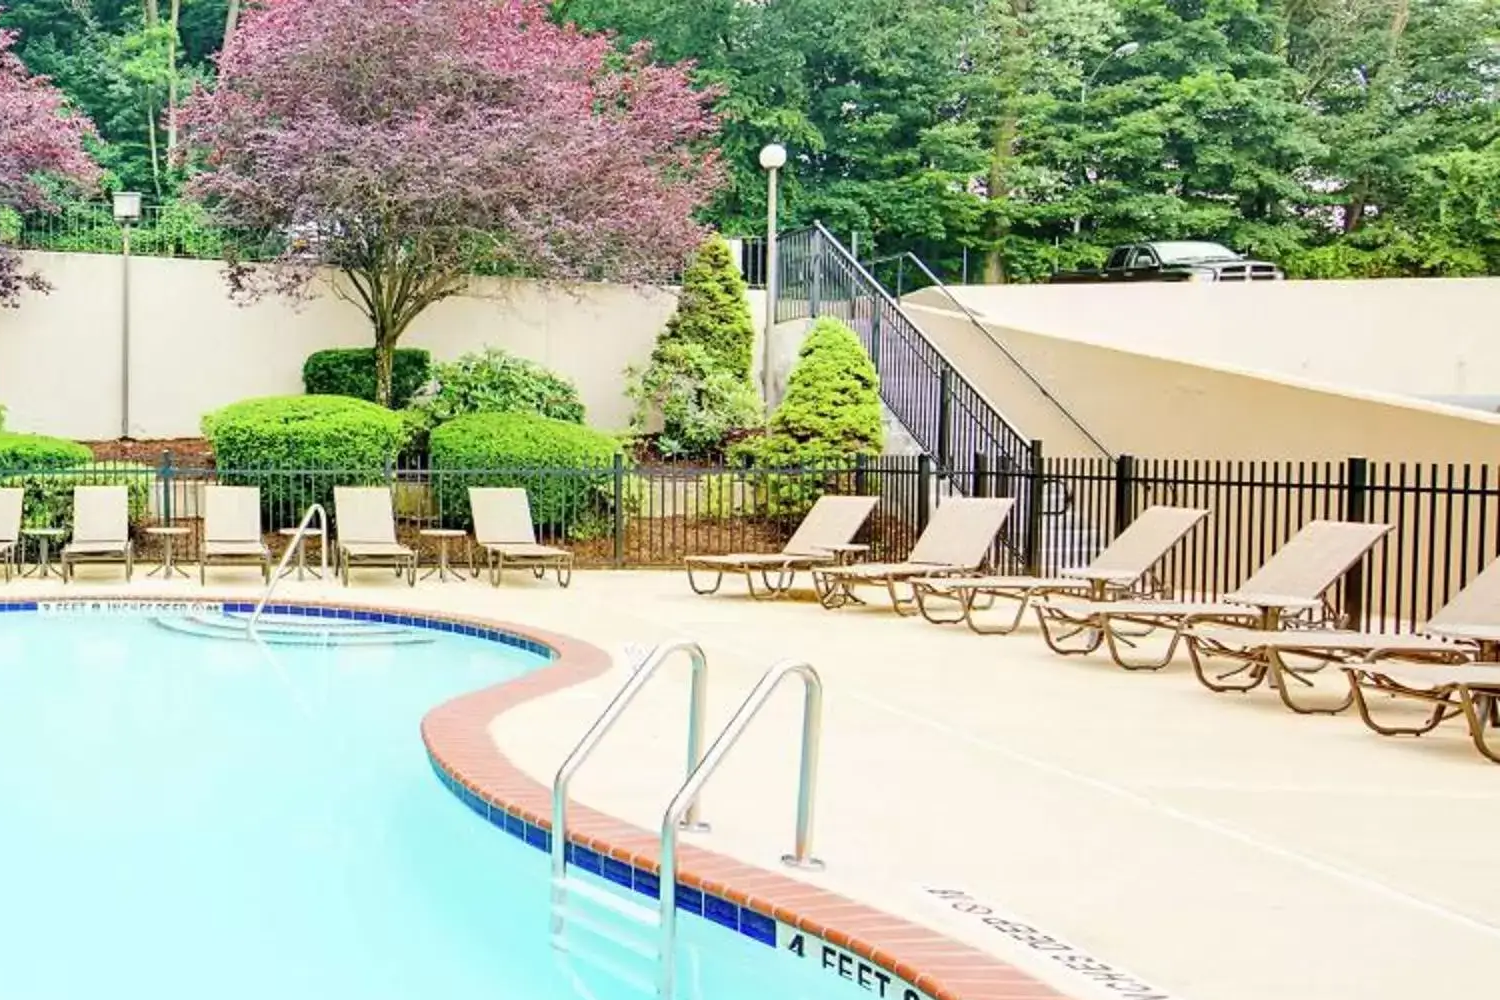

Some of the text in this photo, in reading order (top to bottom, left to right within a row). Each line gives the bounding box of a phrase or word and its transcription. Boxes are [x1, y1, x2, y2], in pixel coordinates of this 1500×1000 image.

[981, 917, 1074, 951] DEEP
[788, 933, 807, 959] 4
[821, 946, 891, 999] FEET
